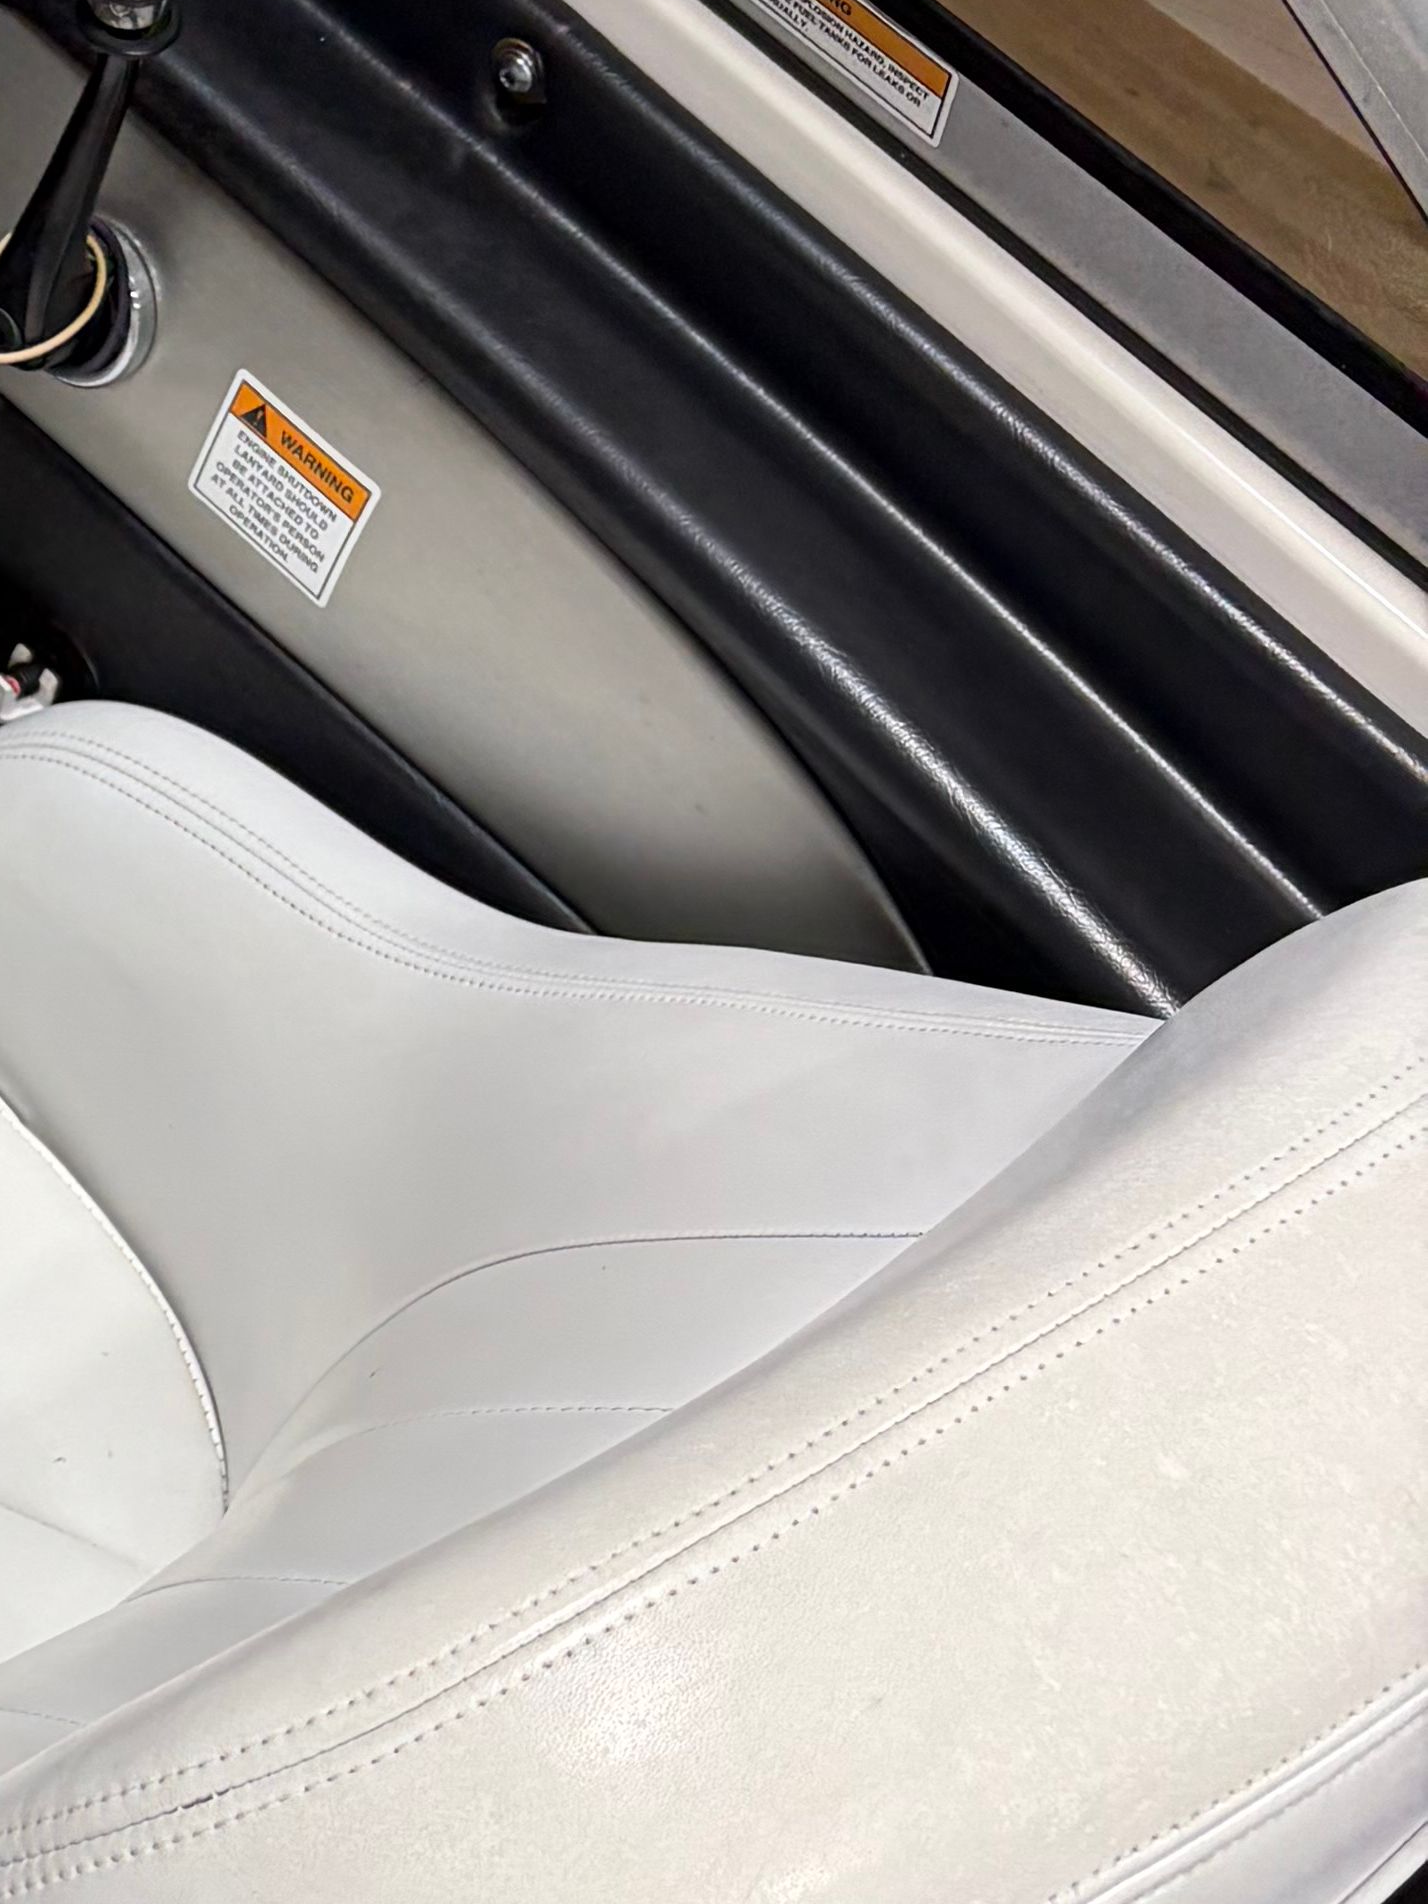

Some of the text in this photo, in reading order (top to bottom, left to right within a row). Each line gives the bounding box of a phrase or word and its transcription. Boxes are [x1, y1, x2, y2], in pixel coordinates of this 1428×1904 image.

[792, 0, 819, 26] FUEL
[850, 46, 871, 68] FOR
[871, 63, 905, 94] LEAKS
[905, 89, 921, 107] OR
[232, 459, 319, 539] BE ATTACHED TO
[234, 444, 327, 531] LANYARD SHOULD
[237, 430, 336, 521] ENGINE SHUTDOWN
[278, 429, 355, 503] WARNING
[211, 472, 318, 573] AT ALL TIMES DURING
[281, 520, 324, 562] PERSON
